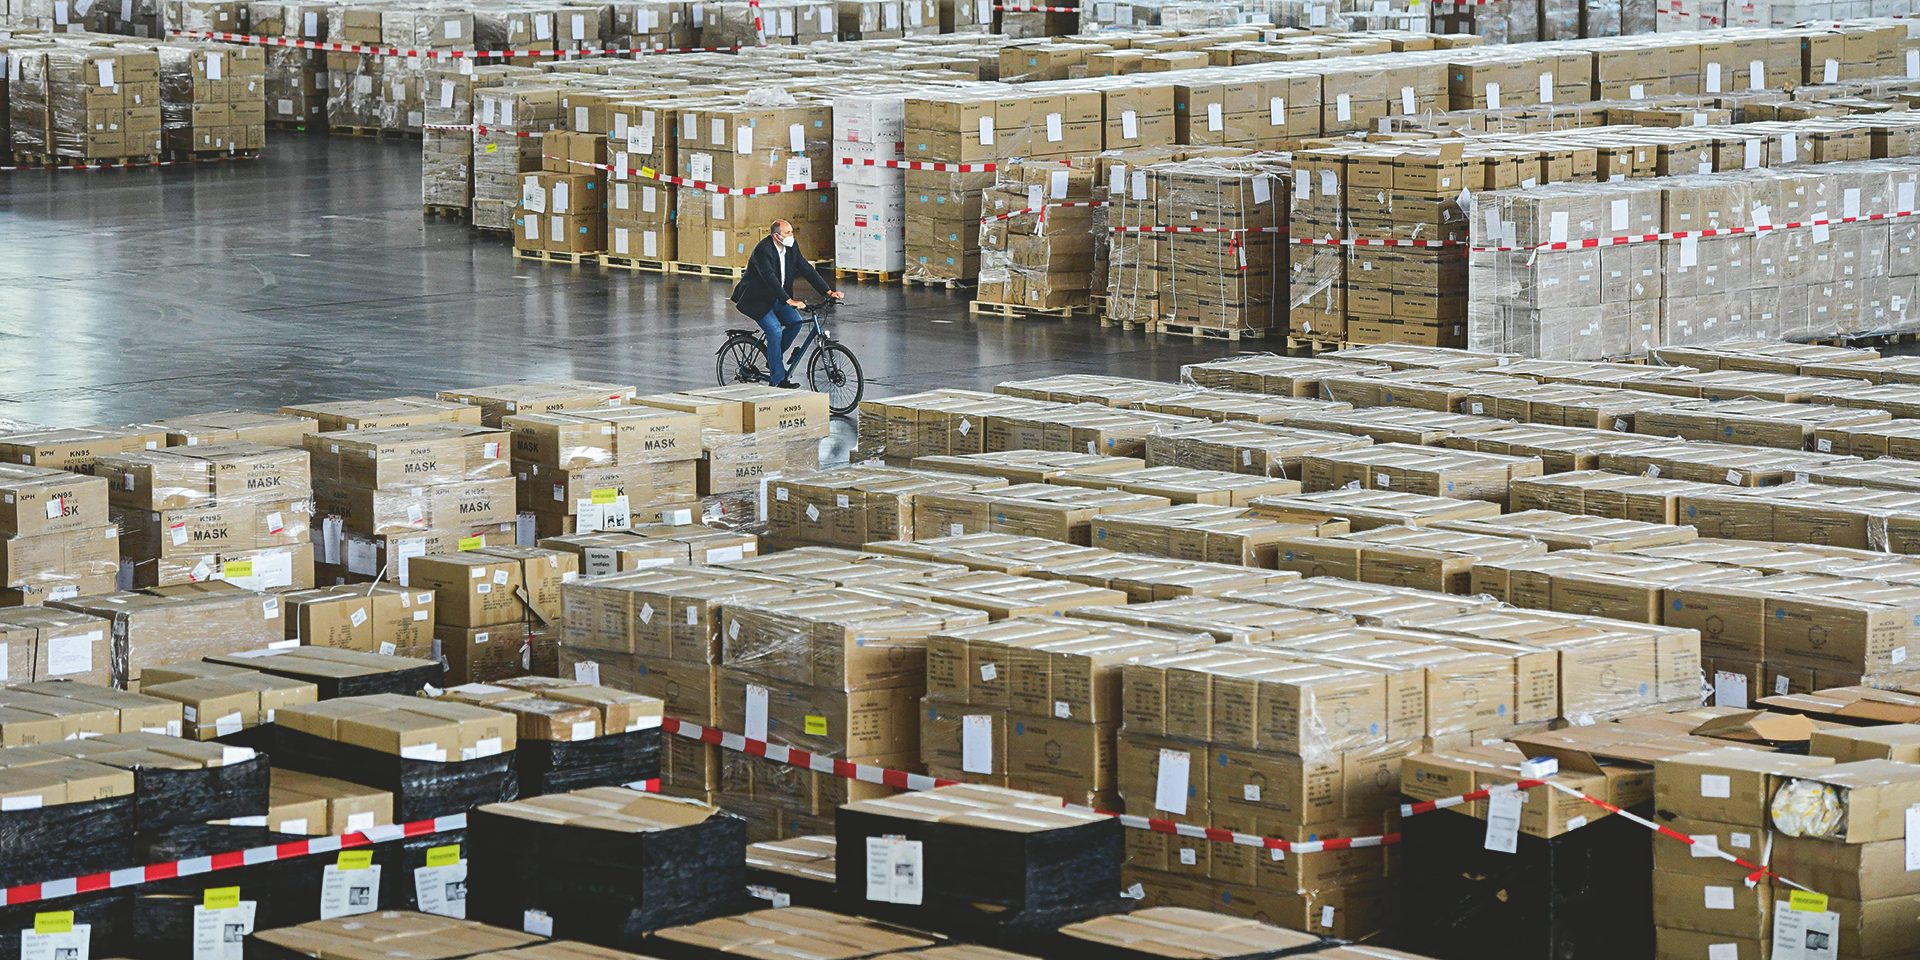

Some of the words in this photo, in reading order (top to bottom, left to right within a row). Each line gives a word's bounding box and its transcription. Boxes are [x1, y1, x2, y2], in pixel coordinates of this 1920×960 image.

[546, 403, 564, 412] KN95
[784, 405, 802, 413] KN95
[779, 417, 807, 429] MASK
[650, 425, 670, 433] KN95
[517, 440, 539, 453] MASK
[645, 438, 676, 451] MASK
[69, 449, 90, 457] KN95
[410, 447, 431, 456] KN95
[404, 460, 437, 474] MASK
[736, 465, 763, 478] MASK
[247, 476, 282, 490] MASK
[51, 490, 73, 501] KN95
[435, 488, 450, 496] XPH
[459, 500, 491, 514] MASK
[200, 513, 222, 523] KN95
[193, 528, 228, 542] MASK
